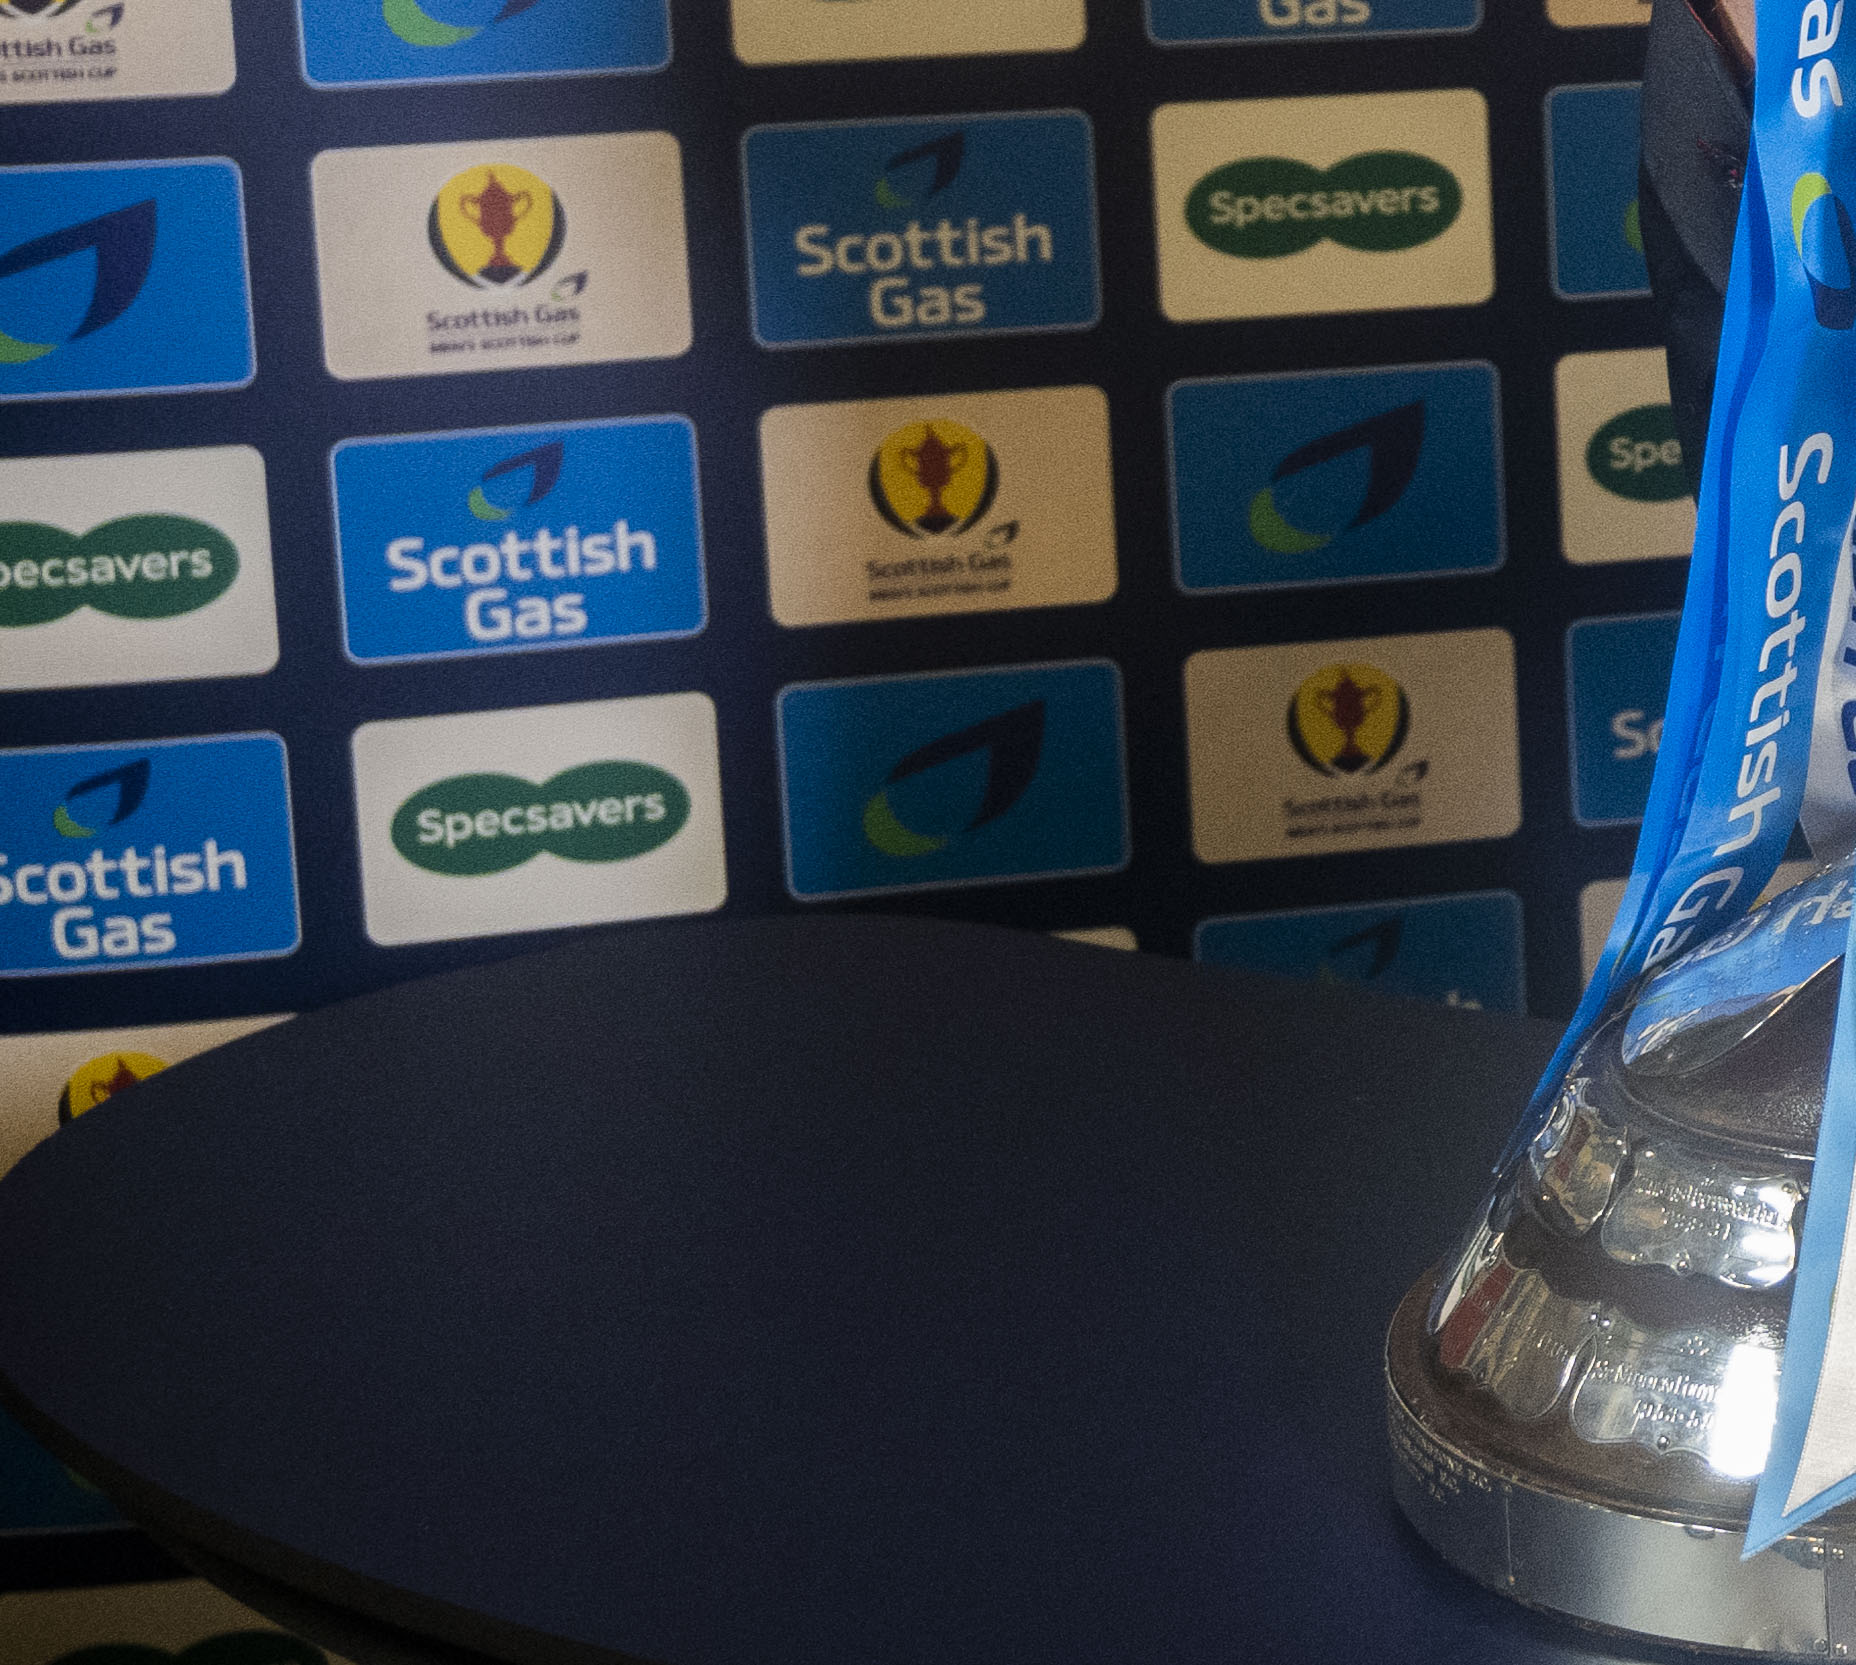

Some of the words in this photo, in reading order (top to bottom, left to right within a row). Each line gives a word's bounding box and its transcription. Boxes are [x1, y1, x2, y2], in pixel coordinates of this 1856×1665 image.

[1208, 181, 1437, 226] Specsavers
[793, 213, 1053, 278] Scottish
[426, 309, 529, 332] Scottish
[868, 275, 986, 329] Gas
[385, 519, 657, 593] Scottish
[463, 586, 589, 643] Gas
[1712, 431, 1834, 858] Scottish
[417, 793, 665, 847] Specsavers
[51, 905, 177, 960] Gas
